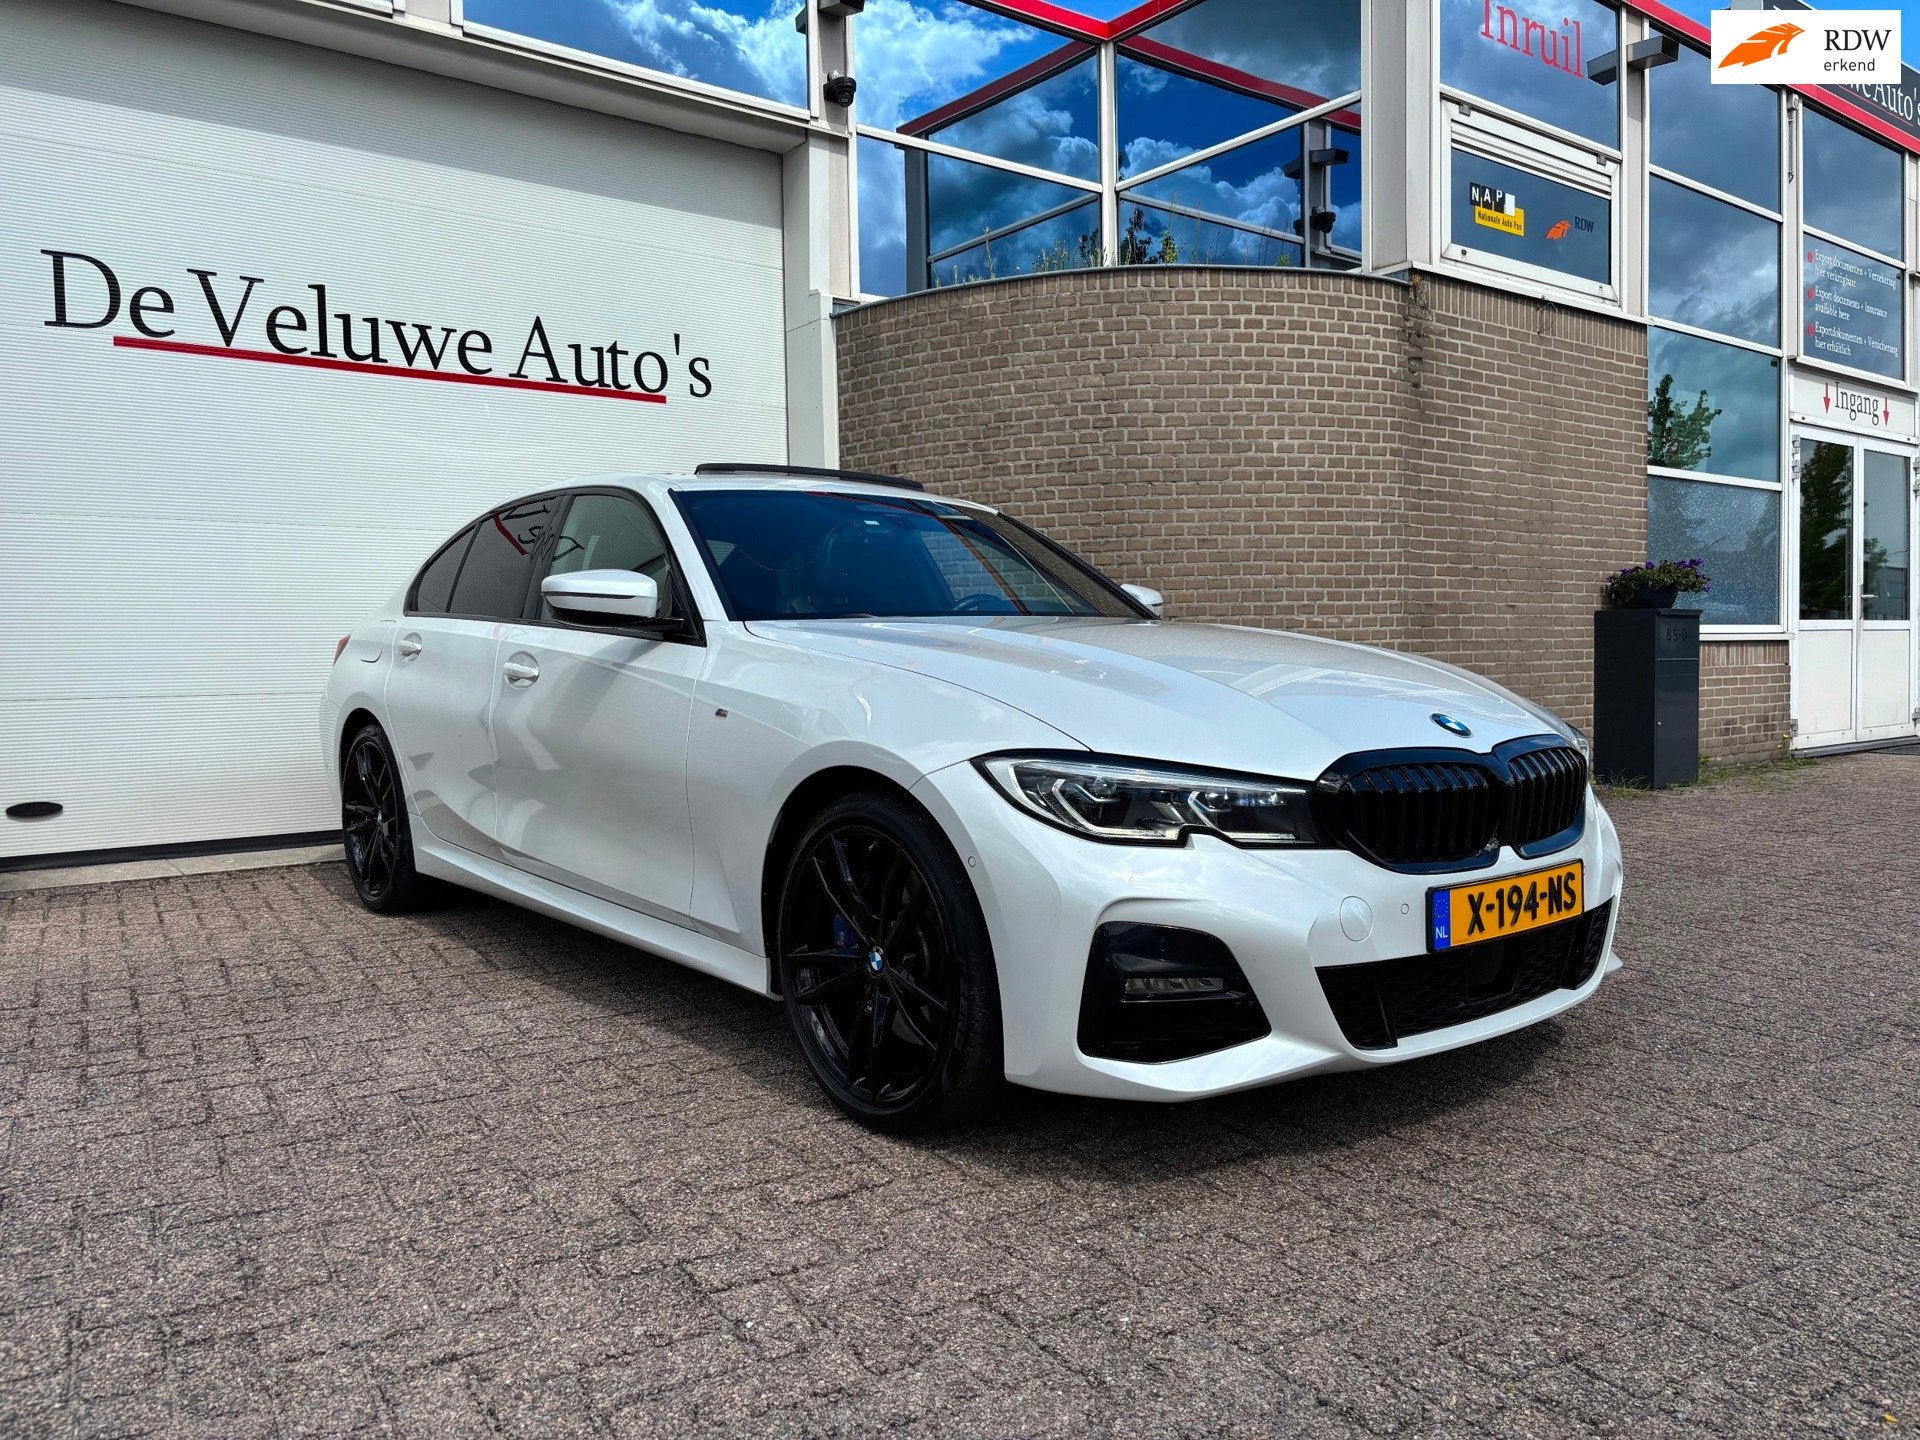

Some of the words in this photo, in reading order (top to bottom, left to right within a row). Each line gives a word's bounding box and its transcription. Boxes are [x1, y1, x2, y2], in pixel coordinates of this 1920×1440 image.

[1480, 0, 1584, 78] Inruil
[1471, 187, 1503, 203] NAP
[1477, 210, 1500, 225] Nationale
[1502, 218, 1513, 229] Auto
[1513, 221, 1522, 231] Pas
[1574, 216, 1595, 233] RDW
[1814, 285, 1832, 302] Export
[1833, 292, 1860, 310] documents
[1815, 302, 1837, 317] available
[1838, 306, 1850, 321] here
[40, 248, 176, 339] De
[186, 267, 494, 377] Veluwe
[508, 314, 713, 399] Auto's
[1834, 381, 1880, 426] Ingang
[1467, 871, 1577, 936] X-194-NS
[1435, 926, 1448, 939] NL
